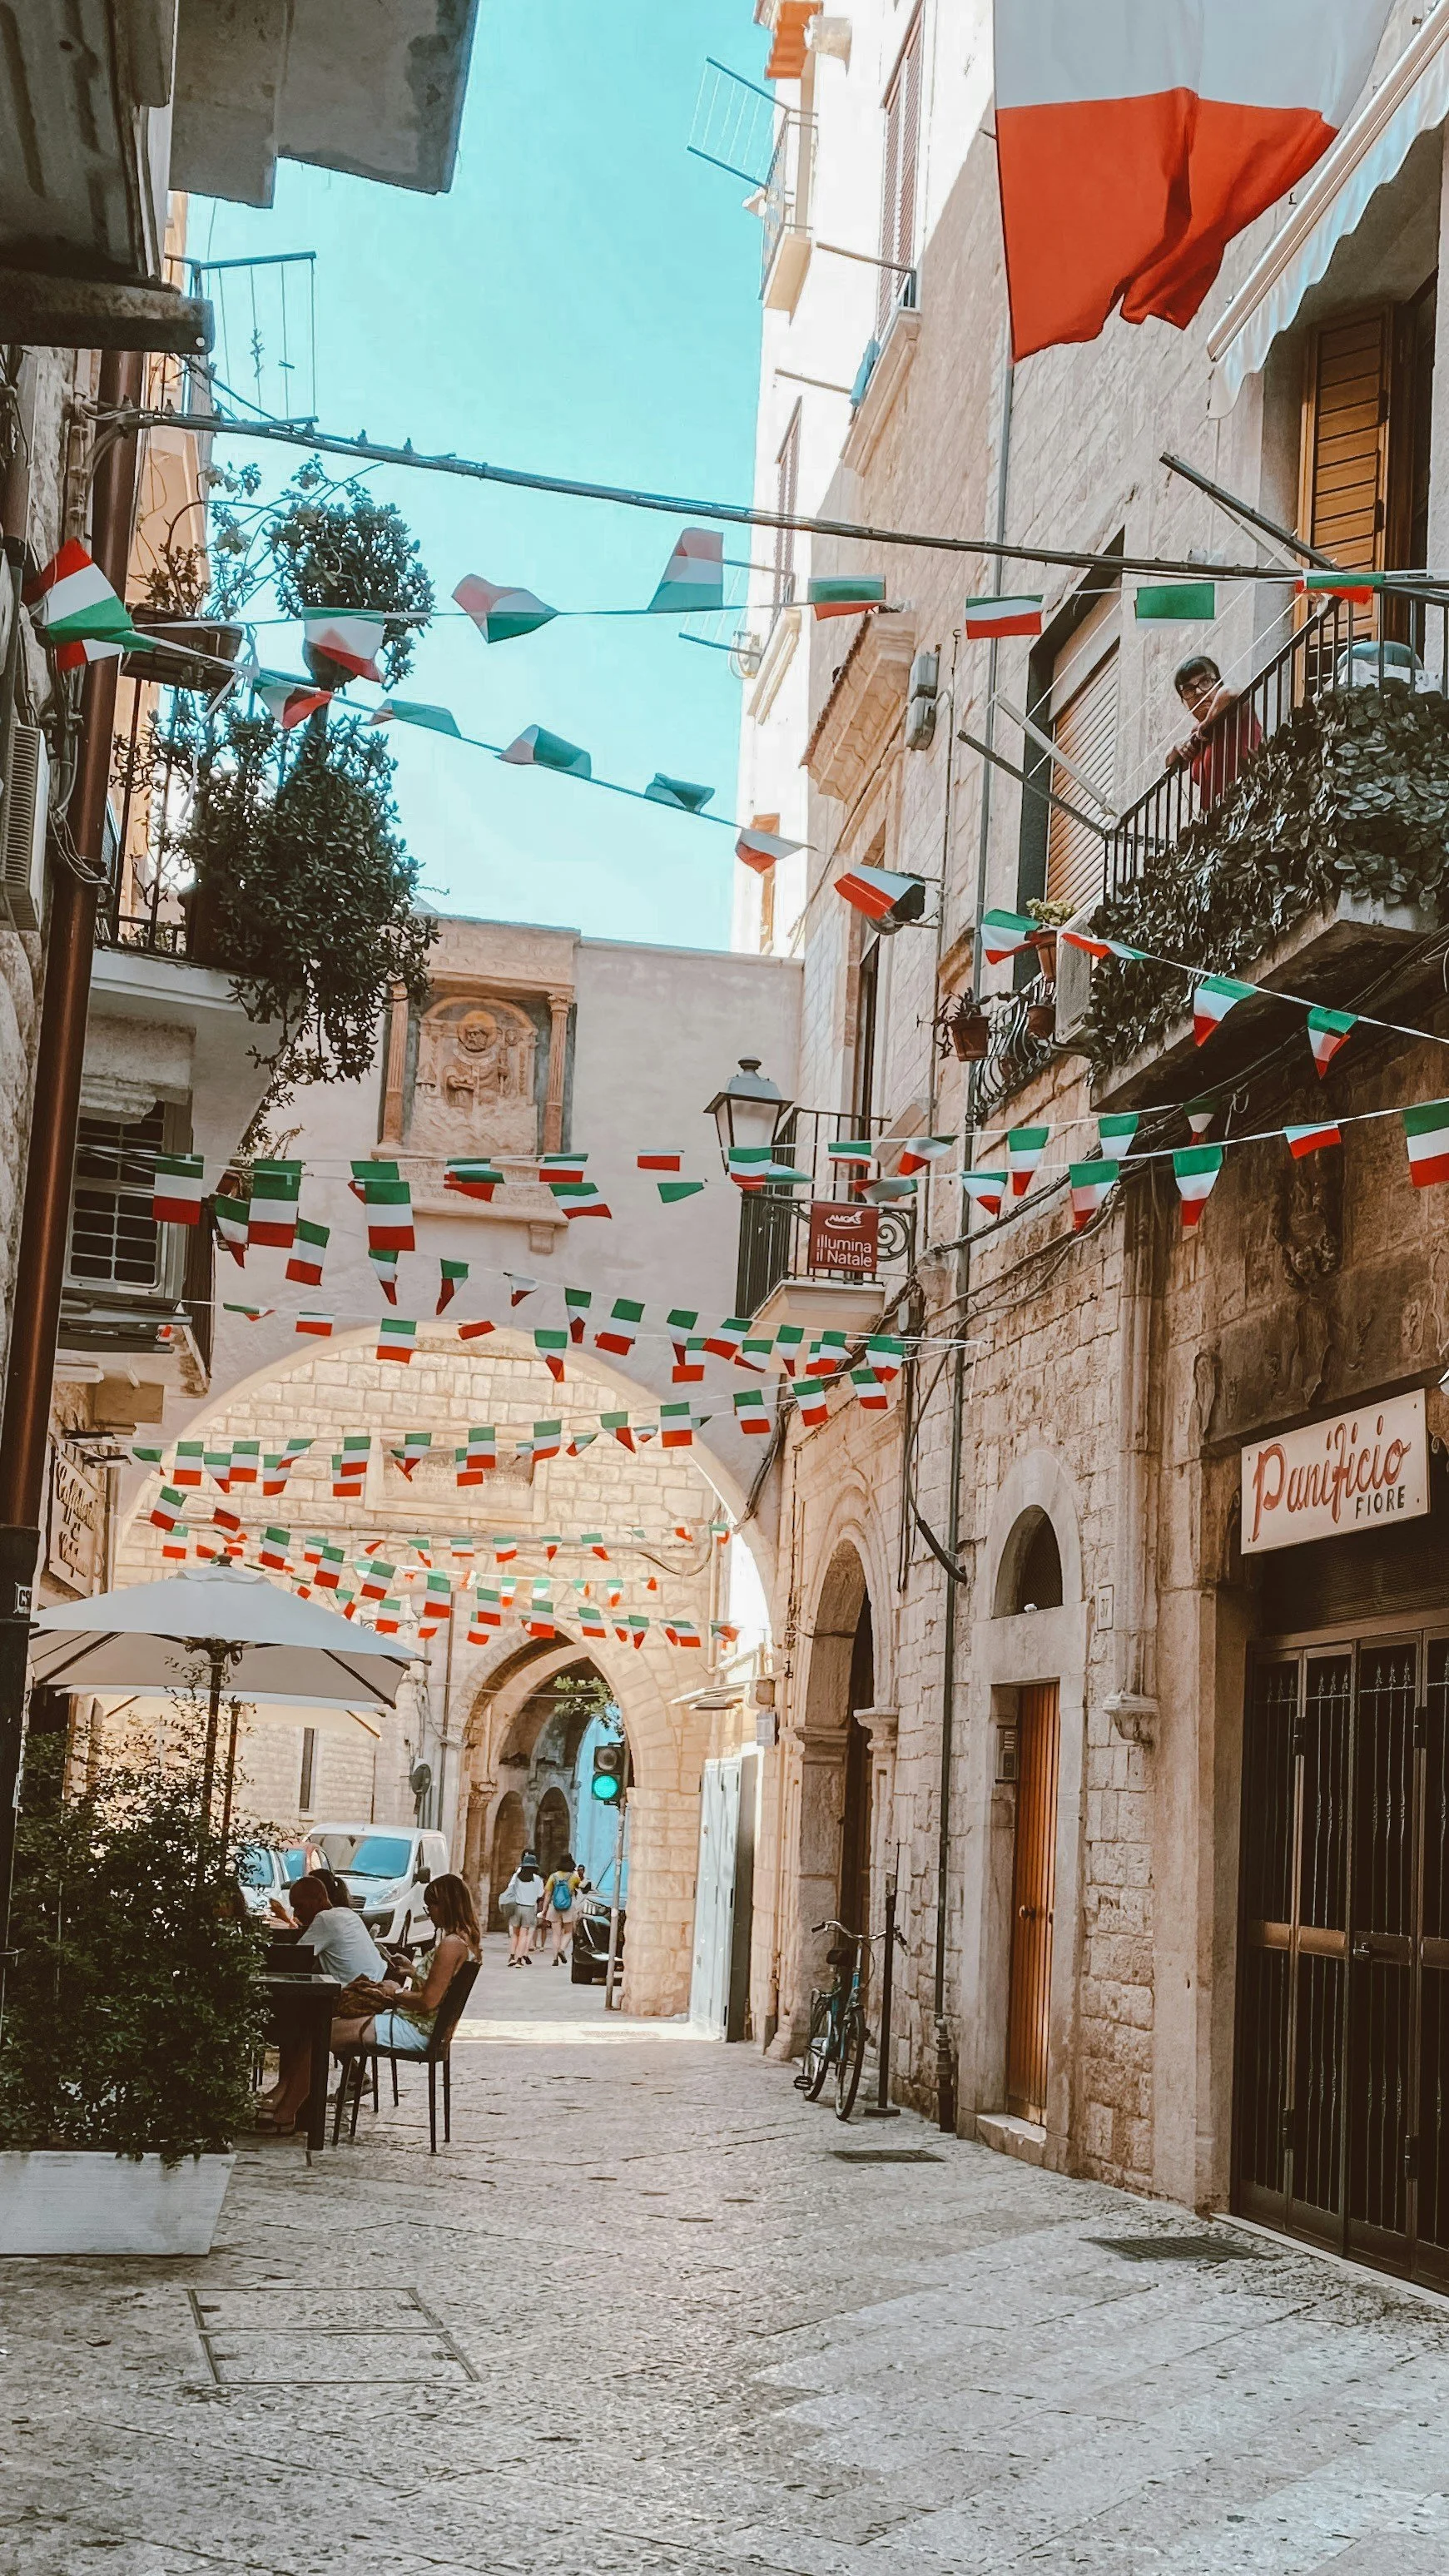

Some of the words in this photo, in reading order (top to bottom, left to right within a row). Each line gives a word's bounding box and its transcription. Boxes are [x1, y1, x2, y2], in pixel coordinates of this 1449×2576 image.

[816, 1233, 871, 1253] illumina
[816, 1248, 823, 1261] il
[826, 1249, 872, 1268] Natale
[1252, 1414, 1412, 1542] Panificio
[1355, 1485, 1406, 1520] FIORE
